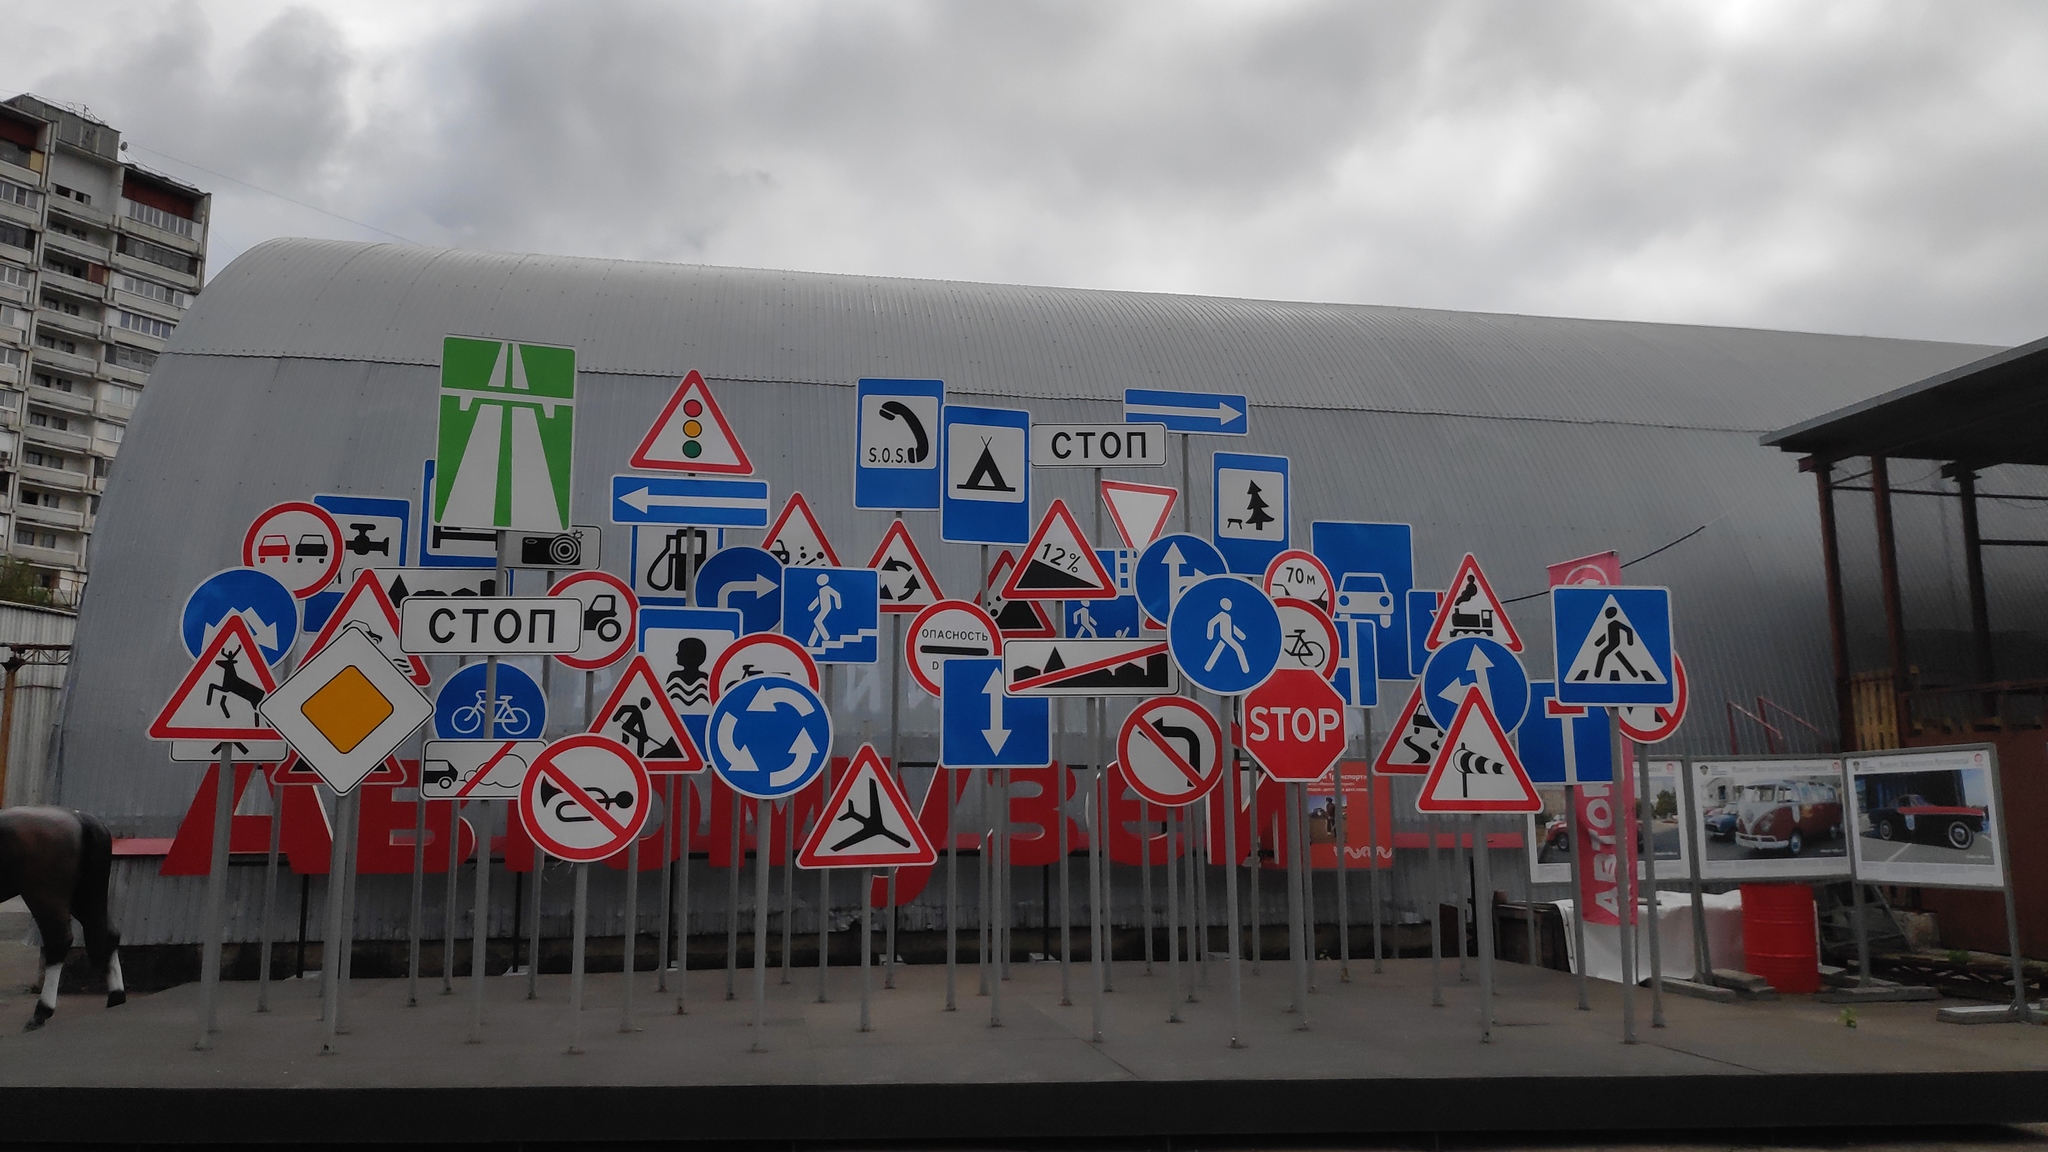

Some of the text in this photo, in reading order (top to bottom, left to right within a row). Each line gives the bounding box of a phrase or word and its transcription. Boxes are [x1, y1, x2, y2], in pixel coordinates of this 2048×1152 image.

[868, 447, 907, 464] S.O.S.
[1051, 431, 1147, 459] СТОП
[1042, 543, 1081, 573] 12%
[429, 608, 556, 644] СТОП
[921, 628, 989, 642] ОПАСНОСТЬ
[1249, 706, 1341, 742] STOP
